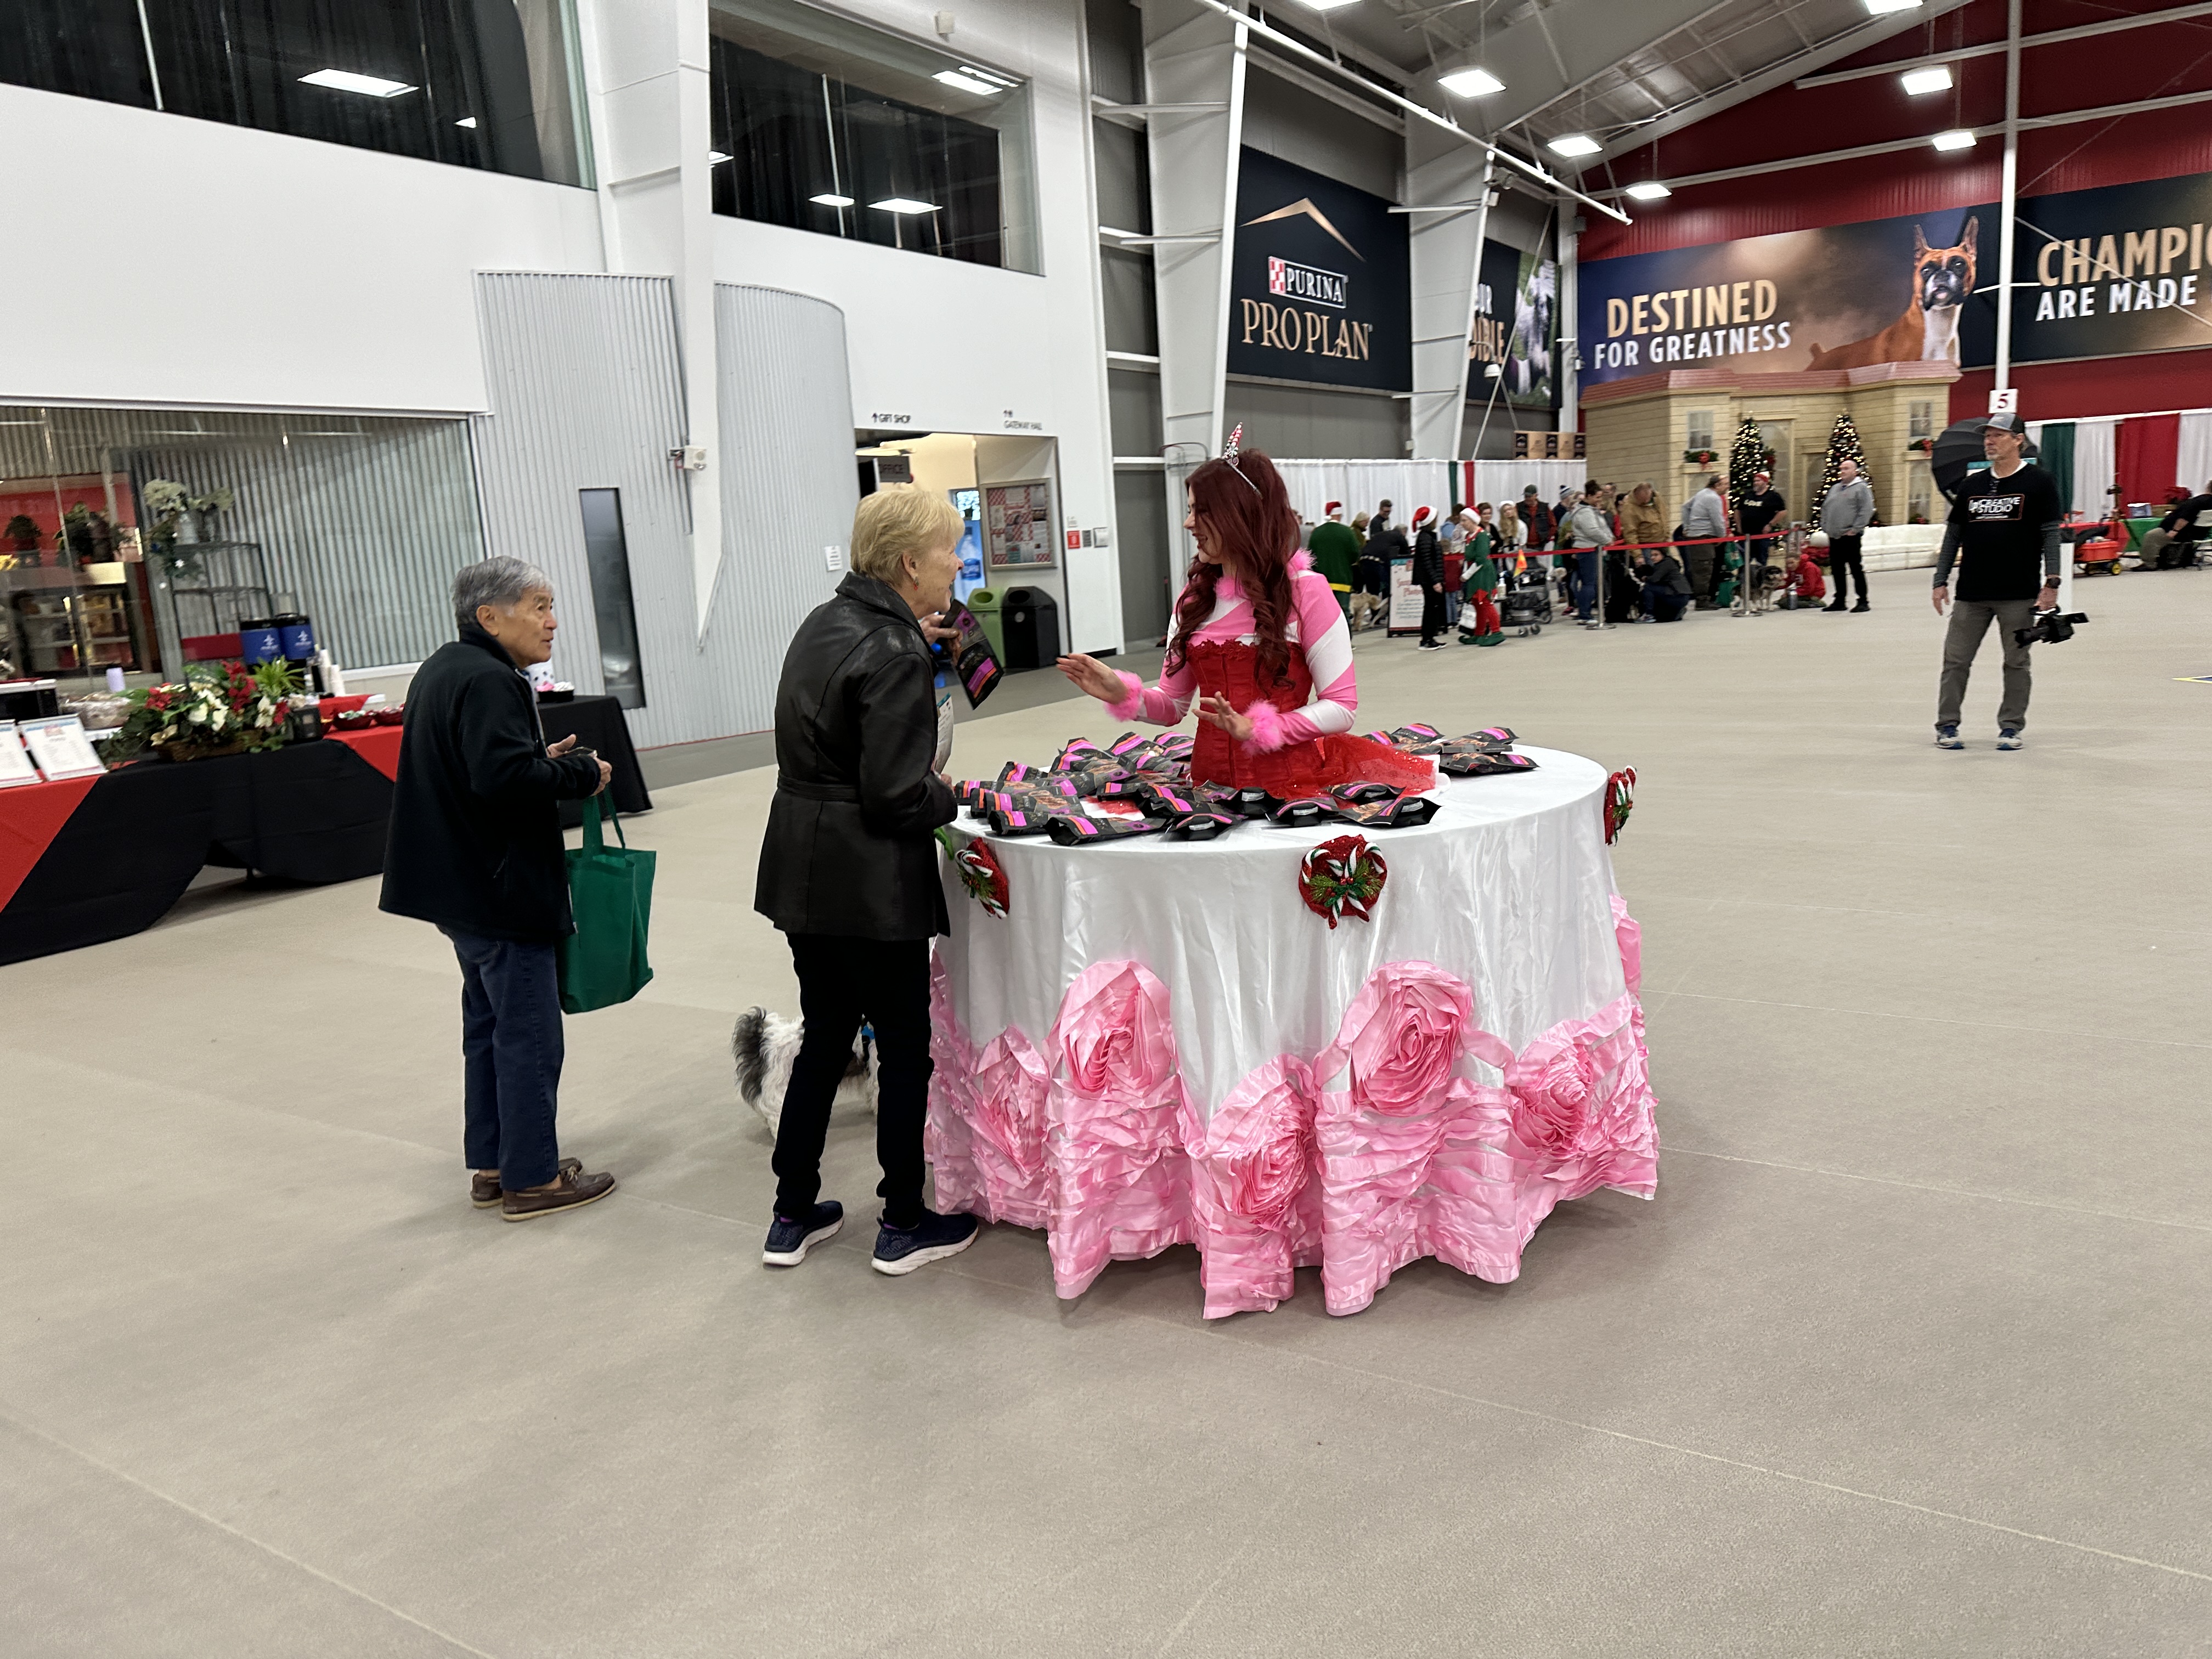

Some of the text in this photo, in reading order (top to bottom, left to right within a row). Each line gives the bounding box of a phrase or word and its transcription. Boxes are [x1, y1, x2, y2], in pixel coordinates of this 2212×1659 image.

[2038, 223, 2212, 286] CHAMPI
[1286, 267, 1344, 303] PURINA
[2036, 287, 2096, 321] ARE
[2109, 275, 2197, 313] MADE
[1607, 279, 1778, 338] DESTINED
[1594, 321, 1791, 370] FOR GREATNESS
[1996, 393, 2009, 409] 5
[1977, 504, 2013, 514] STUDIO
